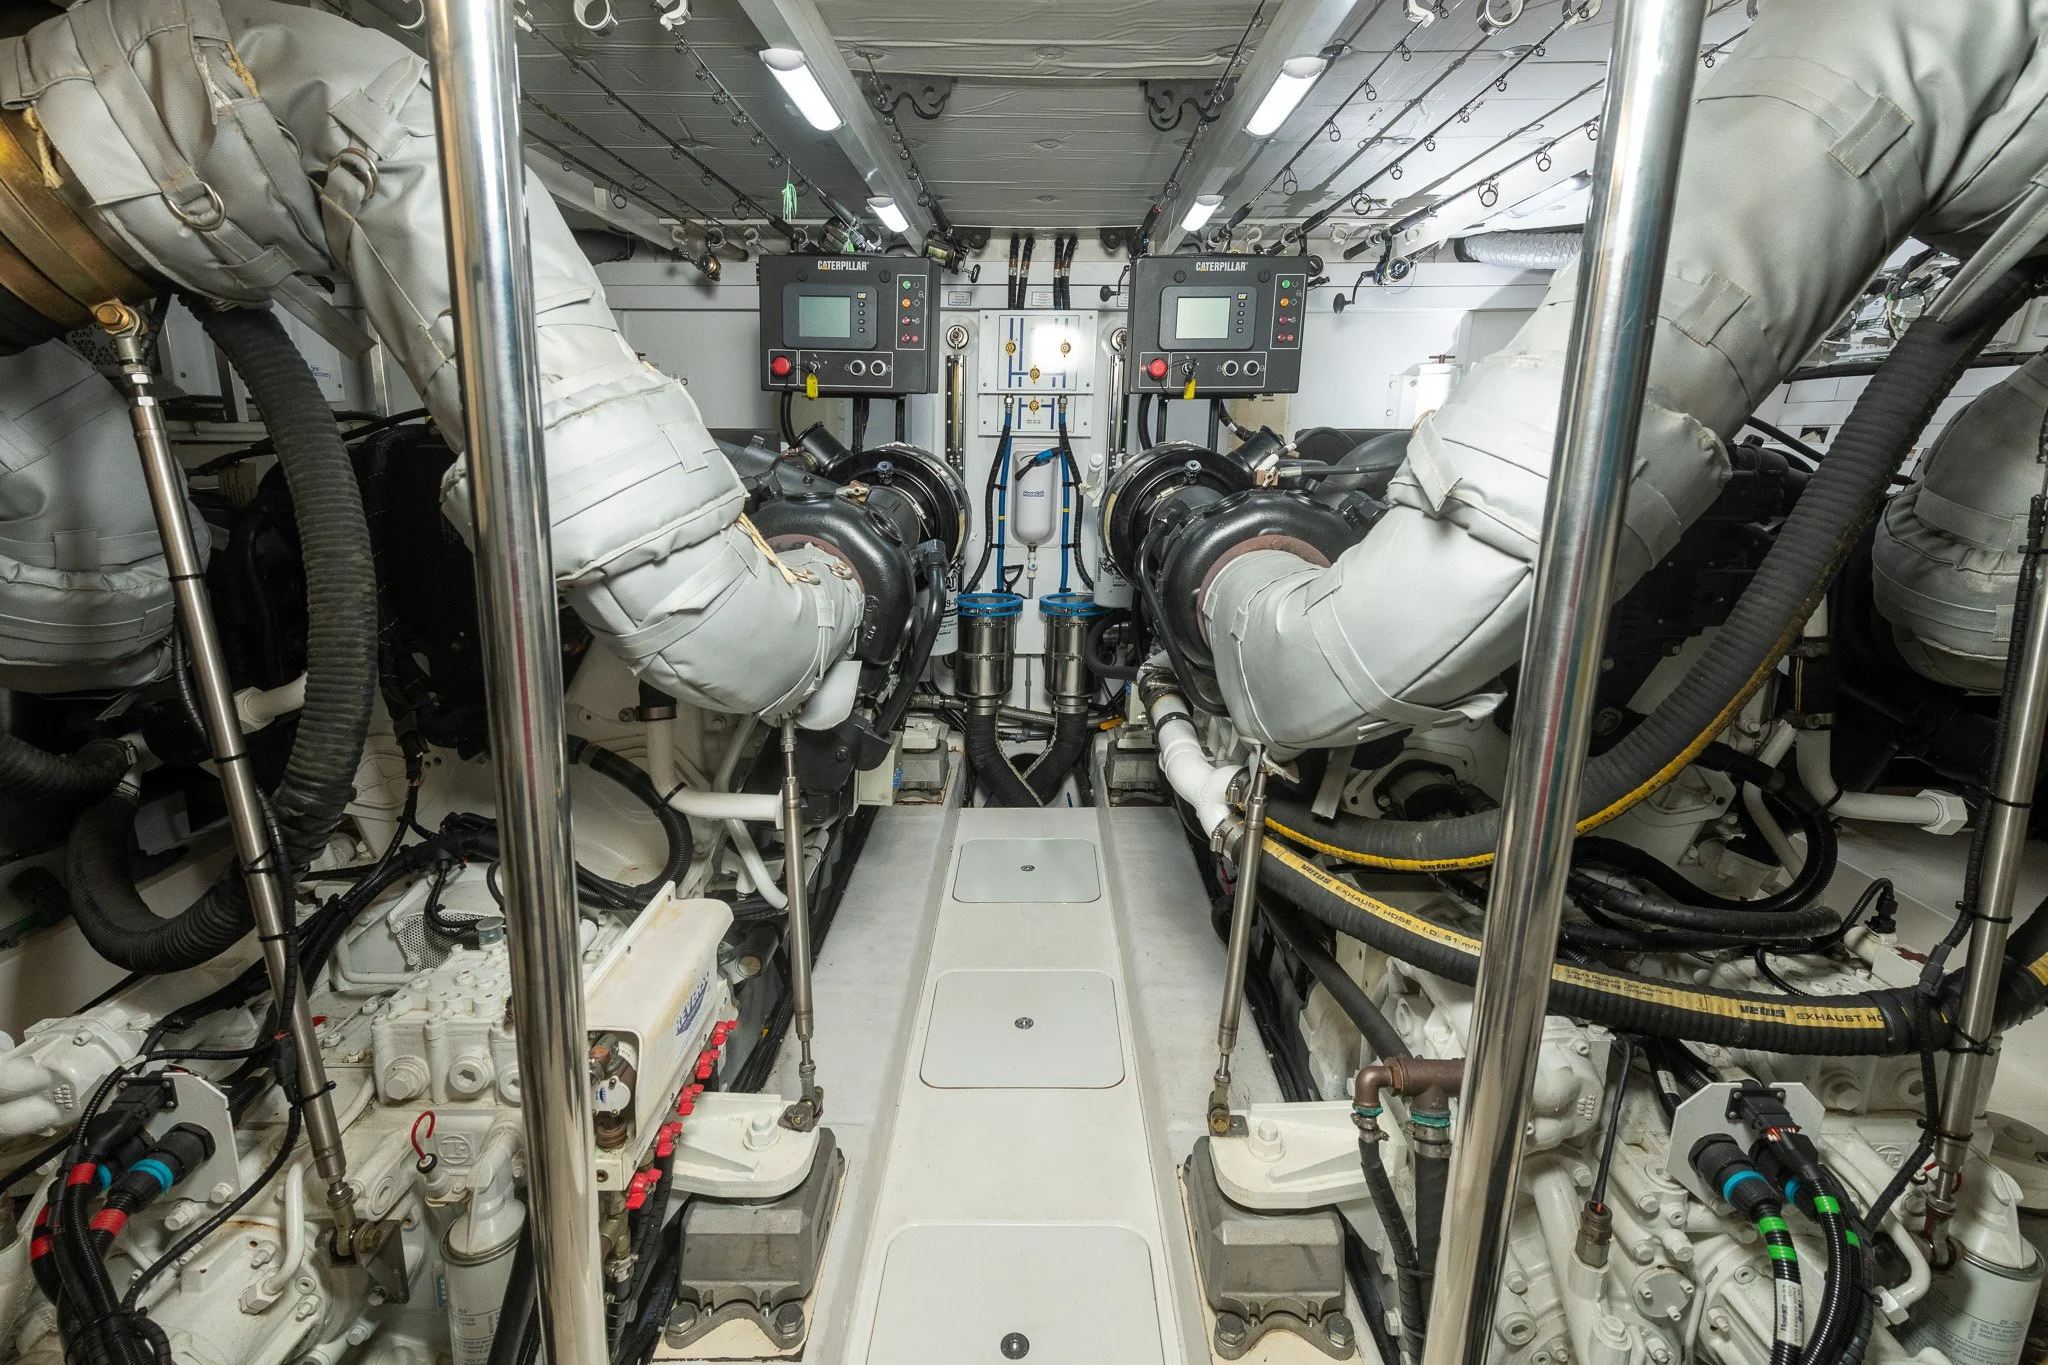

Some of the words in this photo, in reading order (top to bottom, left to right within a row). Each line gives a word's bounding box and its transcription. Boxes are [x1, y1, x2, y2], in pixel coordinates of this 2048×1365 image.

[817, 260, 868, 271] CATERPILLAR
[1195, 261, 1247, 272] CATERPILLAR
[1301, 863, 1332, 884] vetus
[1335, 885, 1381, 911] EXHAUST
[1383, 909, 1413, 926] HOSE
[1422, 926, 1441, 938] I.D.
[1444, 934, 1458, 943] 51
[1461, 942, 1481, 951] mm
[1739, 1004, 1786, 1019] vetus
[1796, 1012, 1862, 1023] EXHAUST
